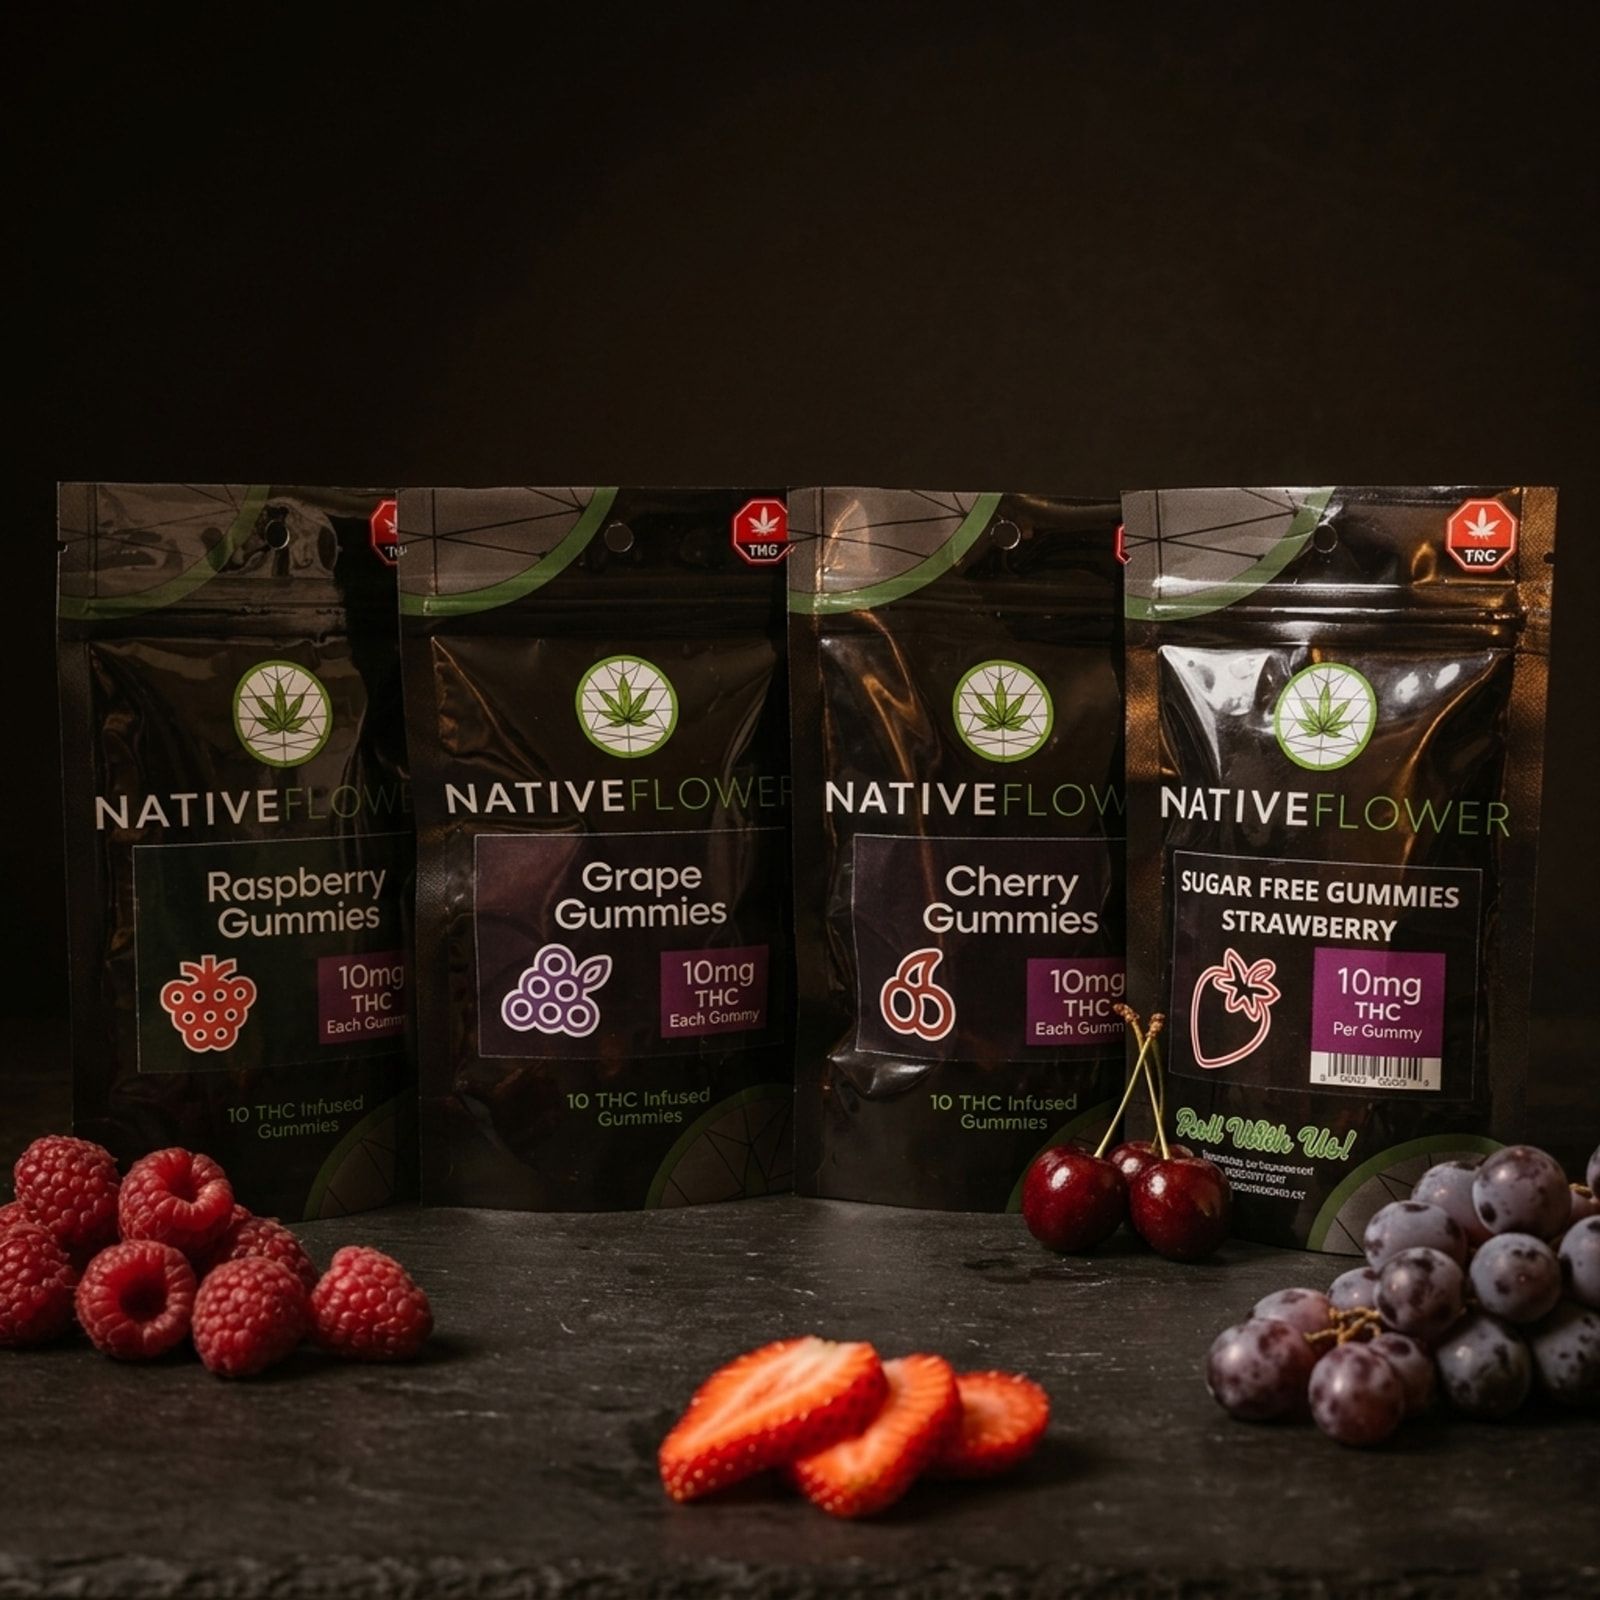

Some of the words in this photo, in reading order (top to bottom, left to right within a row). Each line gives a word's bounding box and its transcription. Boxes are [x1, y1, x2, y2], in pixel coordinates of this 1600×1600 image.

[1161, 785, 1510, 838] NATIVEFLOWER
[207, 867, 387, 906] Raspberry
[581, 861, 703, 897] Grape
[945, 864, 1080, 906] Cherry
[1181, 869, 1252, 899] SUGAR
[1259, 876, 1319, 902] FREE
[1326, 879, 1460, 909] GUMMIES
[217, 901, 381, 939] Gummies
[554, 896, 728, 930] Gummies
[922, 902, 1100, 935] Gummies
[1221, 908, 1398, 942] STRAWBERRY
[338, 964, 404, 990] 10mg
[682, 960, 755, 987] 10mg
[1050, 968, 1126, 998] 10mg
[1337, 966, 1422, 1004] 10mg
[351, 991, 392, 1012] THC
[694, 988, 740, 1008] THC
[1063, 998, 1110, 1017] THC
[669, 1013, 706, 1028] Each
[1354, 1001, 1401, 1021] THC
[327, 1018, 361, 1033] Each
[1036, 1021, 1073, 1036] Each
[1332, 1020, 1357, 1037] Per
[1361, 1022, 1424, 1043] Gummy
[566, 1092, 590, 1109] 10
[594, 1091, 638, 1107] THC
[643, 1086, 710, 1105] Infused
[930, 1093, 953, 1110] 10
[958, 1093, 1002, 1110] THC
[1006, 1092, 1077, 1111] Infused
[227, 1106, 249, 1122] 10
[256, 1102, 295, 1120] THC
[597, 1109, 683, 1126] Gummies
[960, 1112, 1048, 1130] Gummies
[257, 1118, 339, 1139] Gummies
